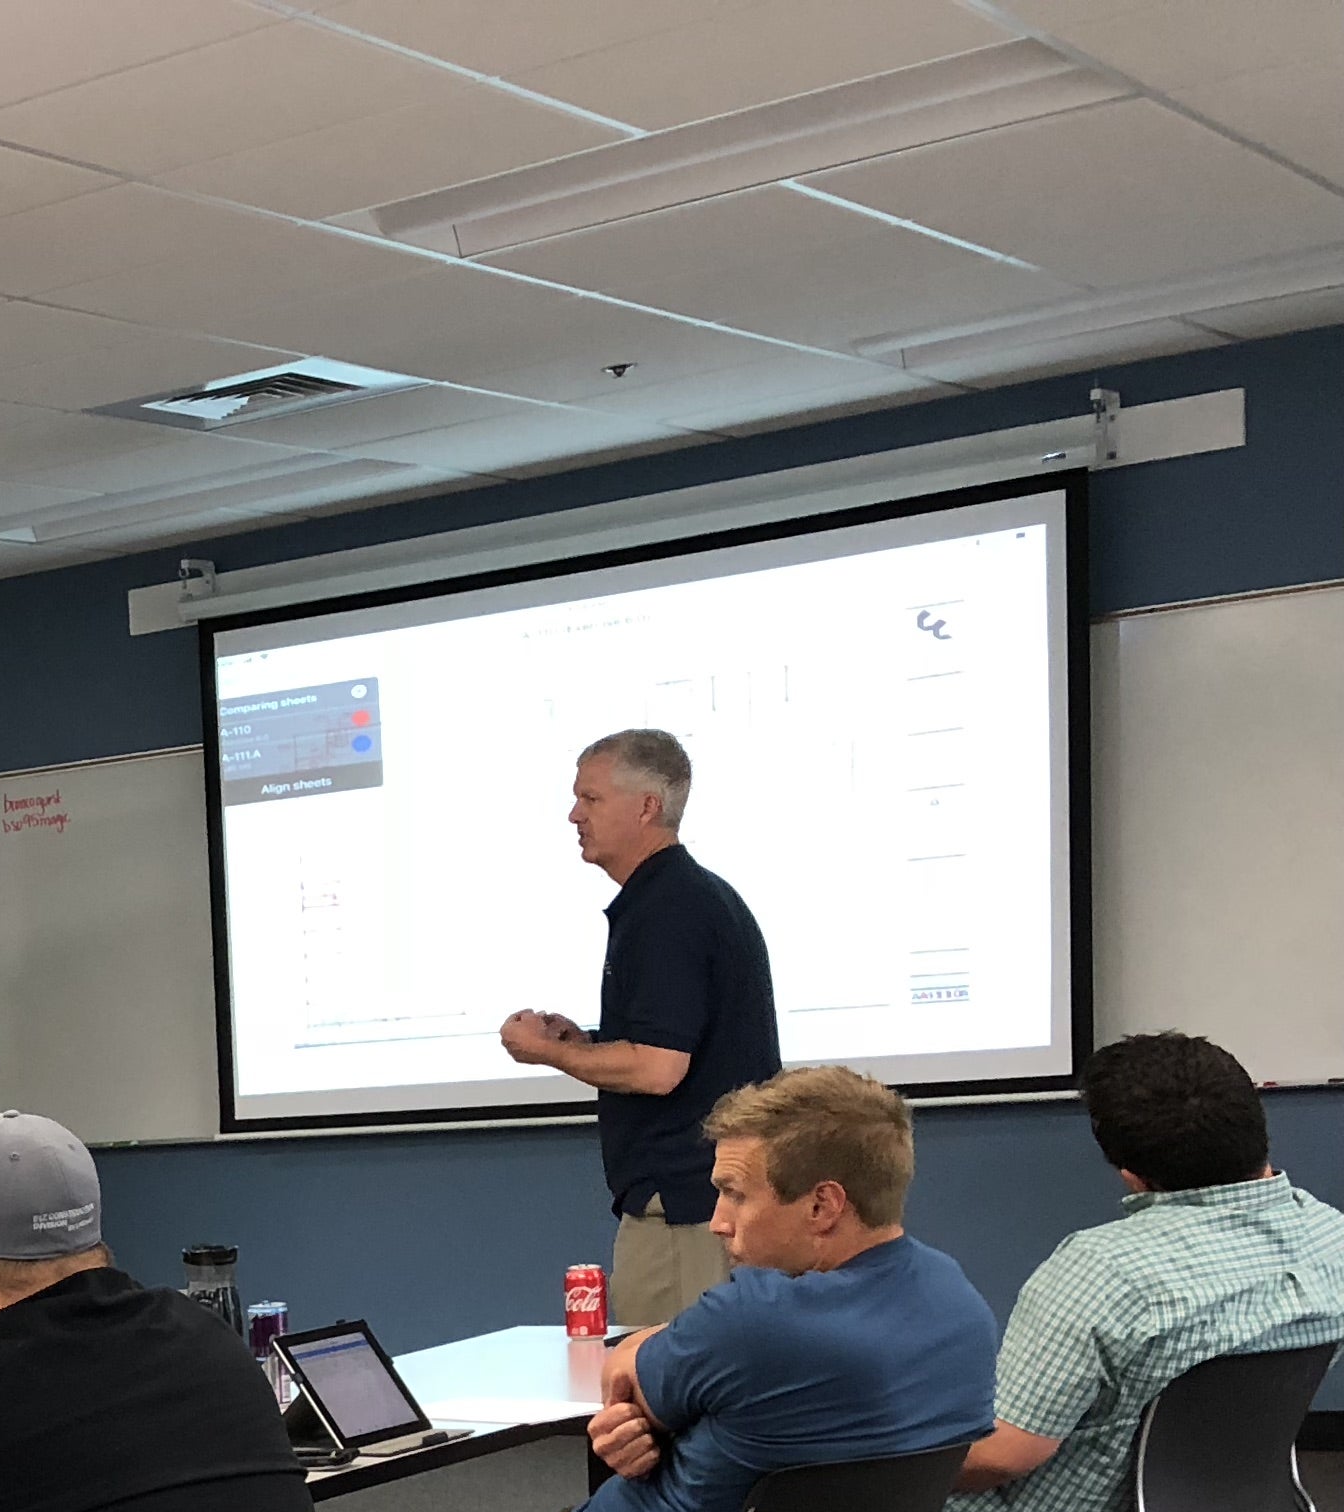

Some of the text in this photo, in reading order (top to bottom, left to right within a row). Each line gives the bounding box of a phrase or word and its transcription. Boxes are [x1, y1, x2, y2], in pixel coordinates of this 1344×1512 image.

[219, 694, 318, 717] Comparing sheets
[220, 724, 252, 737] A-110
[261, 776, 333, 795] Align sheets
[565, 1286, 603, 1312] Cola
